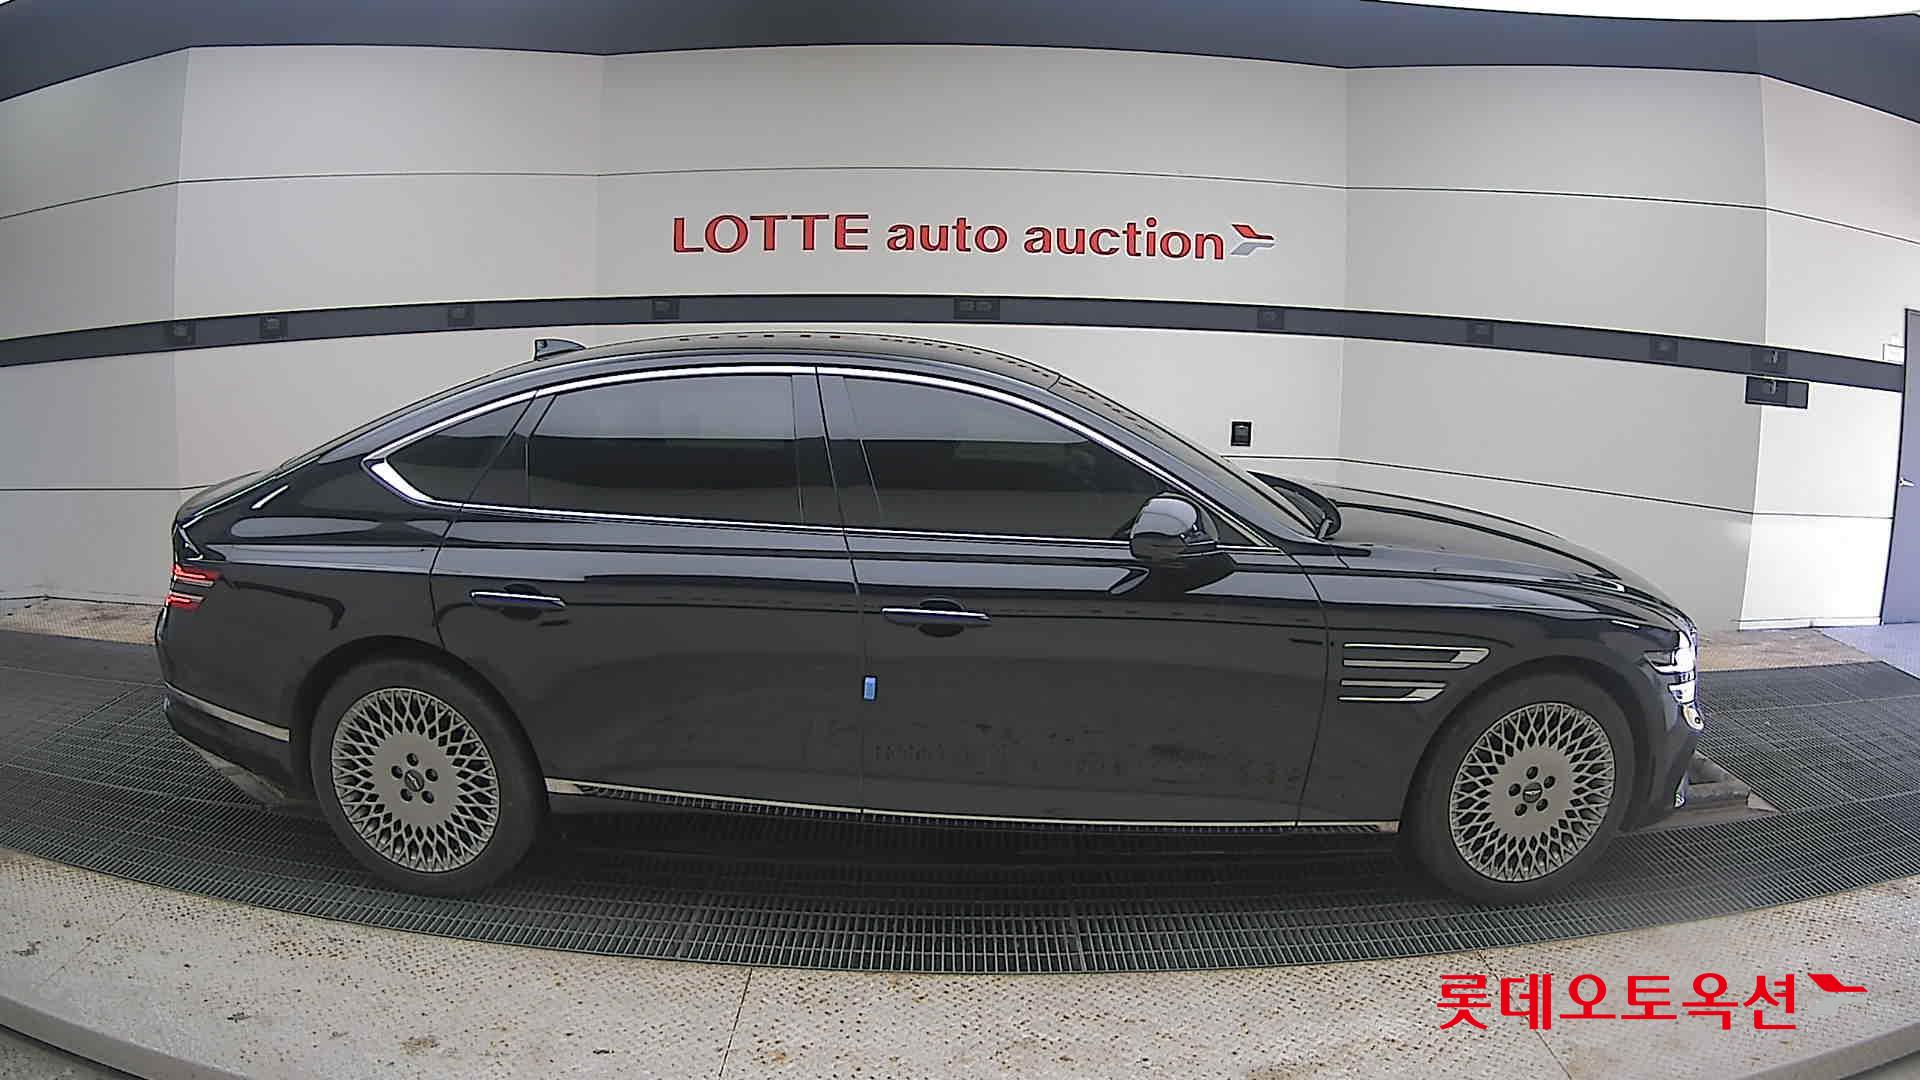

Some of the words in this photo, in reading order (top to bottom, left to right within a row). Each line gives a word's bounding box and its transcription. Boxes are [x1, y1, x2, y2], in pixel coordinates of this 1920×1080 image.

[673, 214, 868, 253] LOTTE
[887, 217, 1007, 253] auto
[1024, 217, 1224, 261] auction
